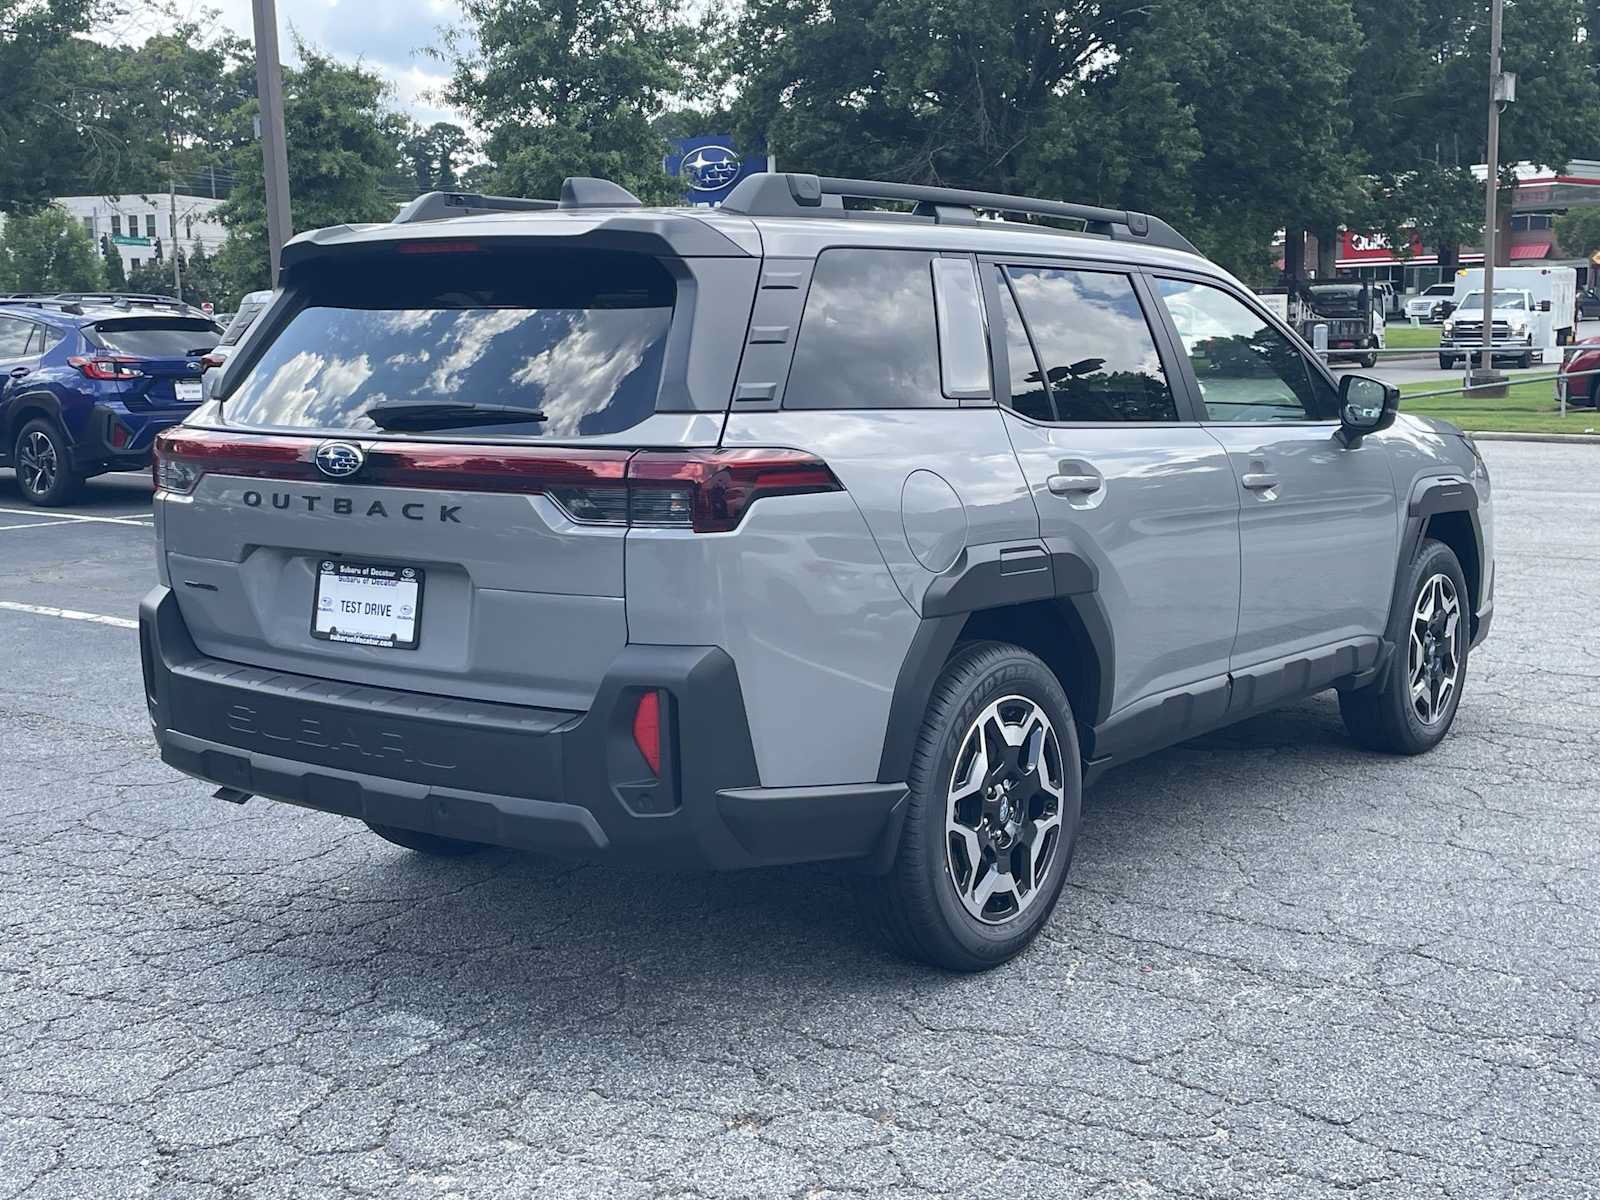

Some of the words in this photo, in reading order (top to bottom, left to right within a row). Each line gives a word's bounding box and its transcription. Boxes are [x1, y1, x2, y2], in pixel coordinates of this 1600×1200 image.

[242, 490, 463, 524] OUTBACK
[339, 565, 362, 575] Subaru
[340, 600, 363, 614] TEST
[365, 602, 392, 617] DRIVE
